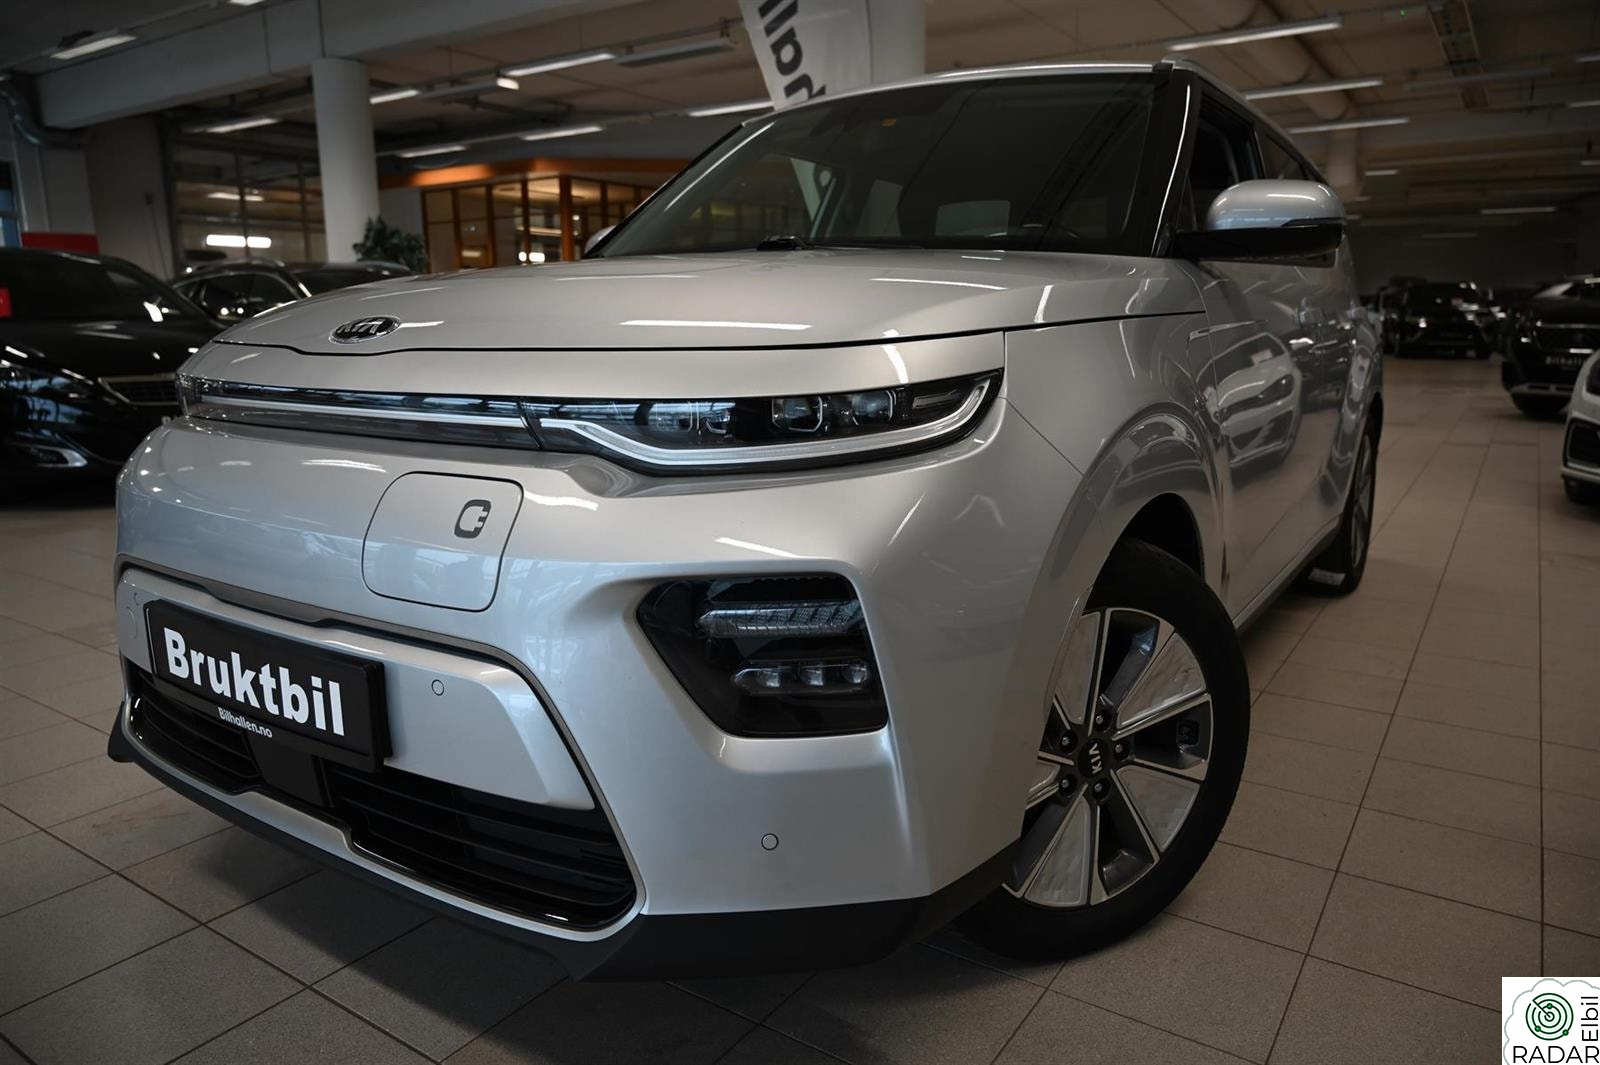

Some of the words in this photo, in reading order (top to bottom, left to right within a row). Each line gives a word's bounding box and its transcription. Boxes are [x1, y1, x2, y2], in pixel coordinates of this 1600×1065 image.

[163, 626, 345, 737] Bruktbil
[217, 706, 273, 739] Bilhallen.no
[1088, 743, 1102, 774] KIA
